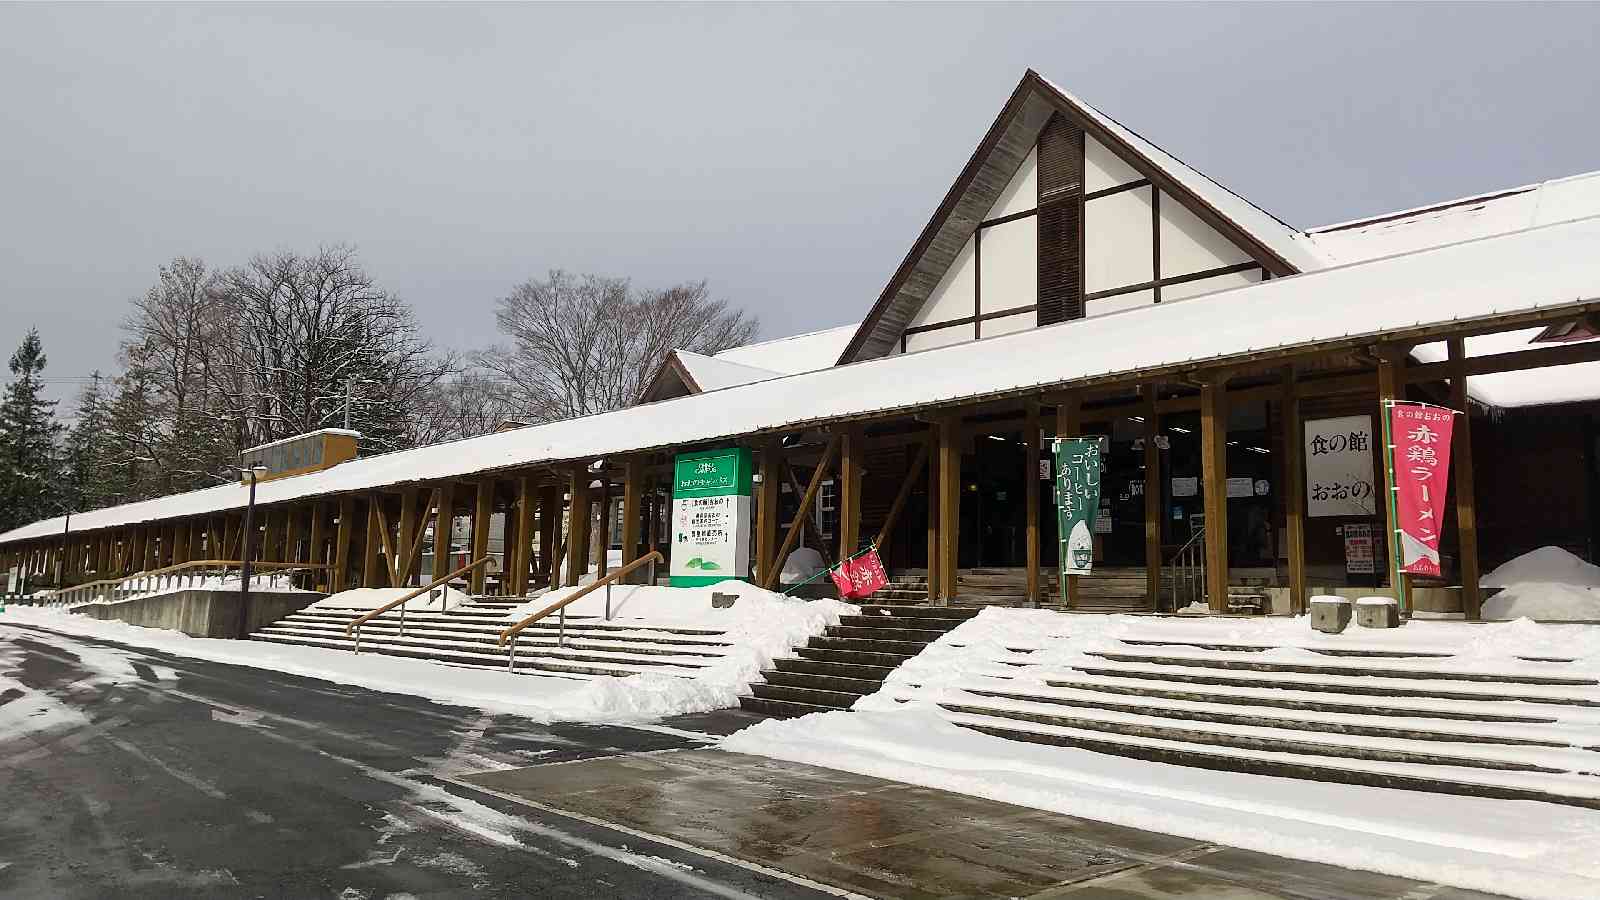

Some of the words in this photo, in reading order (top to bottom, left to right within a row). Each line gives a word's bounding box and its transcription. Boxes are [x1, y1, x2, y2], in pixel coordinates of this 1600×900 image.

[1310, 430, 1369, 456] 食の館
[1397, 409, 1451, 422] 食の館おおの
[1061, 462, 1075, 520] あります
[1072, 454, 1084, 511] コーヒー
[1084, 443, 1099, 500] おいしい
[1312, 480, 1371, 501] おおの
[1406, 424, 1440, 542] 赤鶏ラーメン
